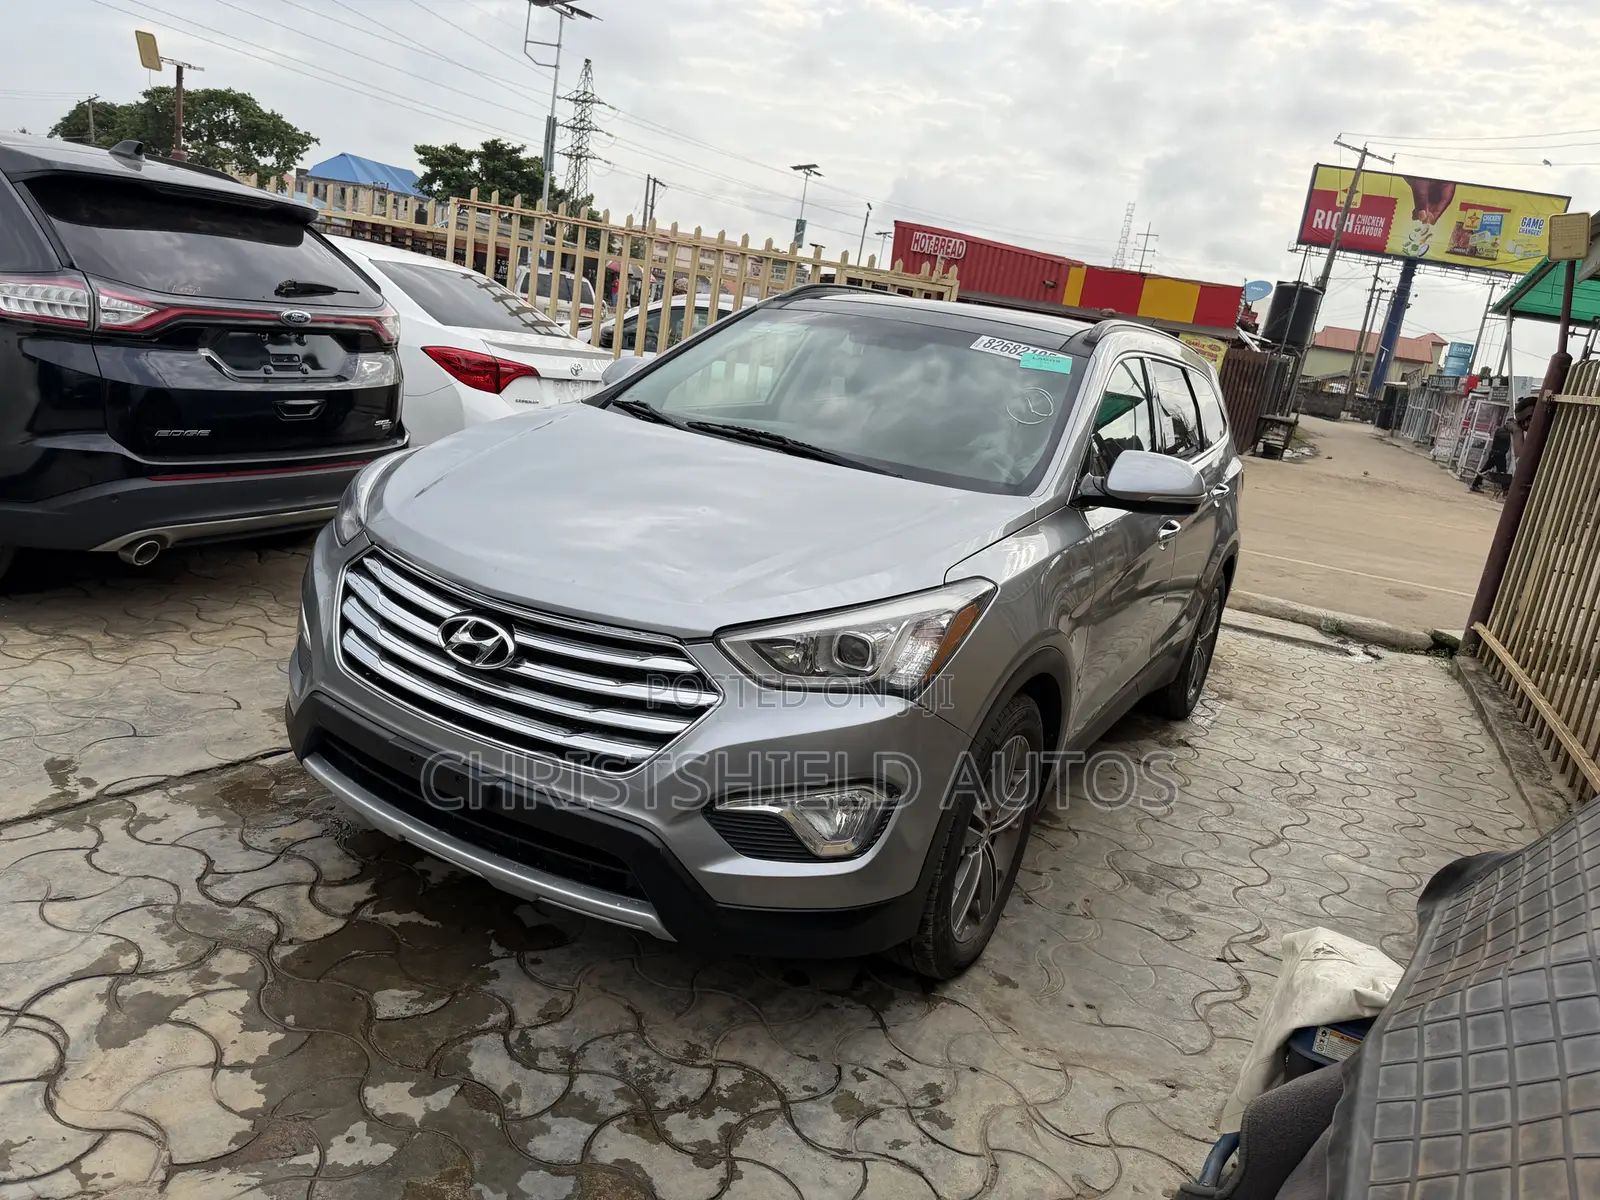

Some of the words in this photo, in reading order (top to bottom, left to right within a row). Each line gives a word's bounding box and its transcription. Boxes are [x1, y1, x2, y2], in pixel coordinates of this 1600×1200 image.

[1356, 214, 1386, 228] CHICKEN
[1353, 224, 1383, 238] FLAVOUR
[154, 429, 211, 437] EDGE
